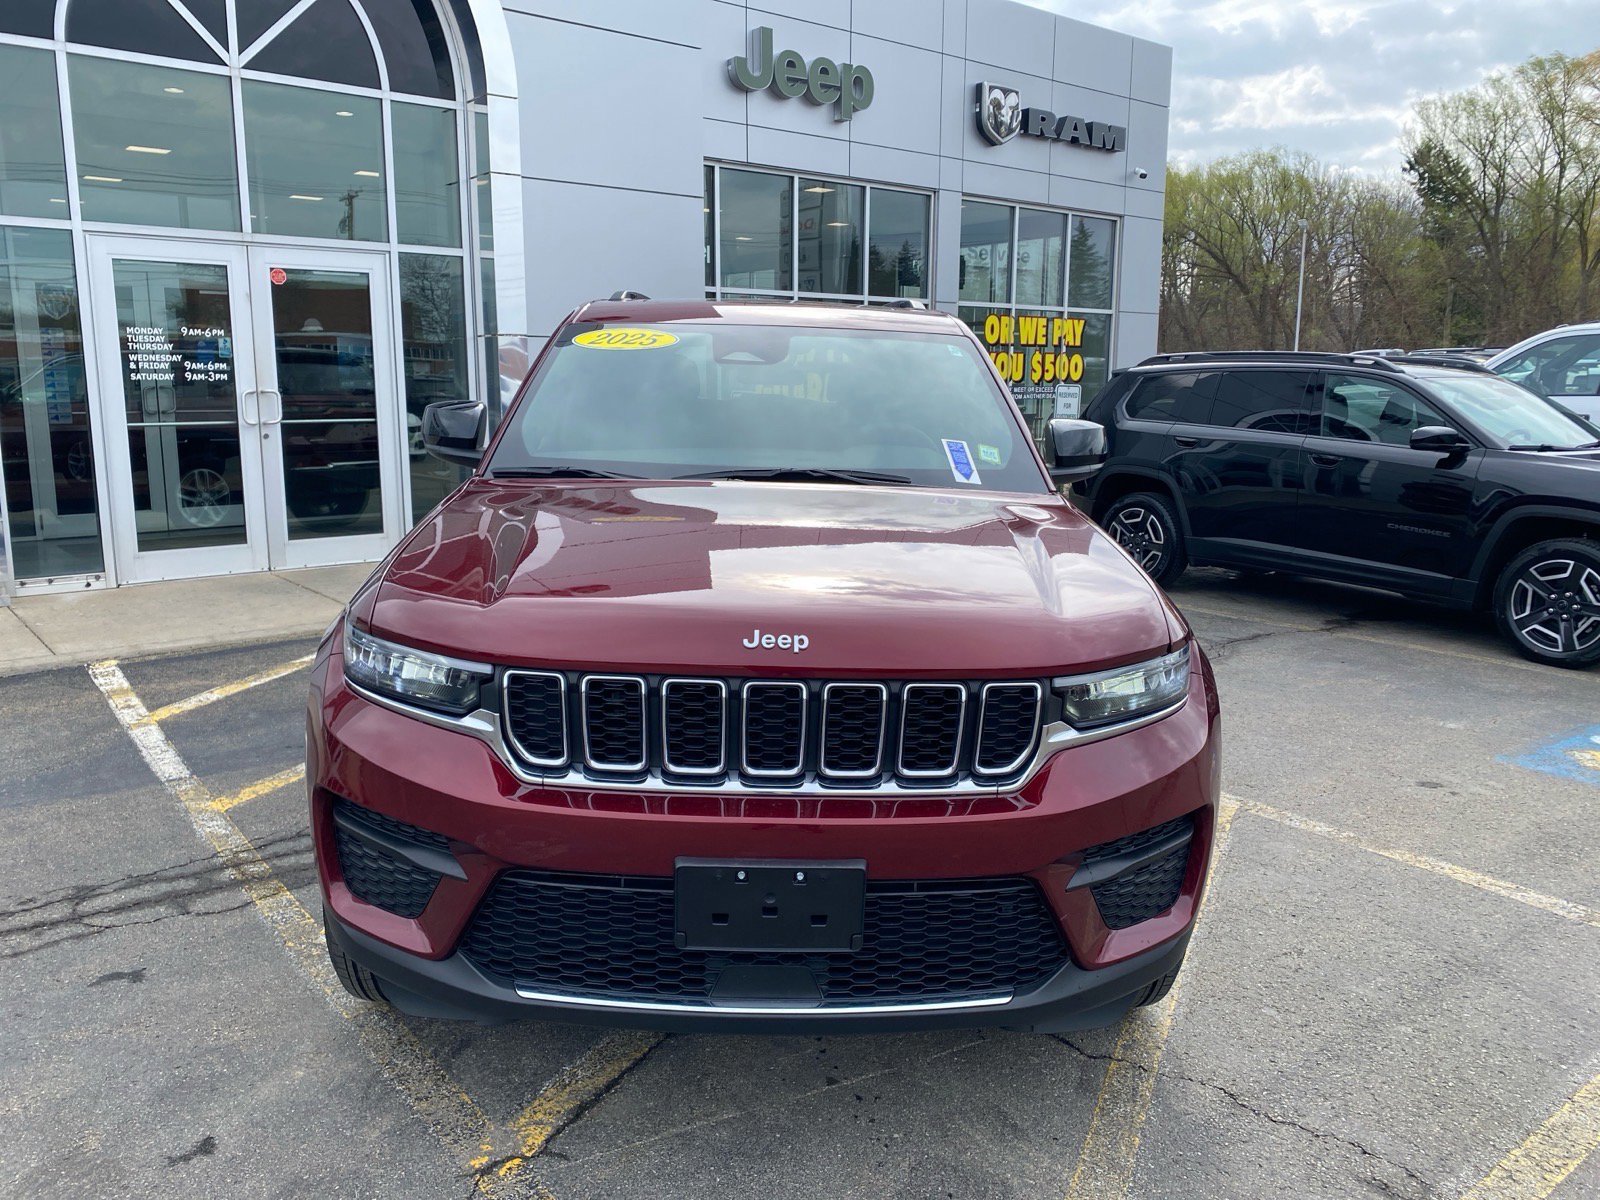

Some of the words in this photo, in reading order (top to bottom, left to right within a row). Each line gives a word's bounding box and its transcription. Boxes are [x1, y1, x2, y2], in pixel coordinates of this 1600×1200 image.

[727, 26, 875, 122] Jeep
[1021, 107, 1127, 152] RAM
[126, 327, 163, 335] MONDAY
[984, 314, 1015, 346] OR
[1018, 315, 1048, 347] WE
[1052, 317, 1086, 348] PAY
[126, 335, 166, 343] TUESDAY
[587, 332, 664, 346] 2025
[127, 342, 174, 351] THURSDAY
[128, 354, 182, 362] WEDNESDAY
[129, 362, 137, 370] &
[138, 362, 170, 370] FRIDAY
[184, 361, 227, 371] 9AM-6PM
[1030, 350, 1085, 385] $500
[130, 373, 175, 381] SATURDAY
[184, 371, 228, 381] 9AM-3PM
[1386, 523, 1452, 538] CHEROKEE
[742, 629, 809, 653] Jeep
